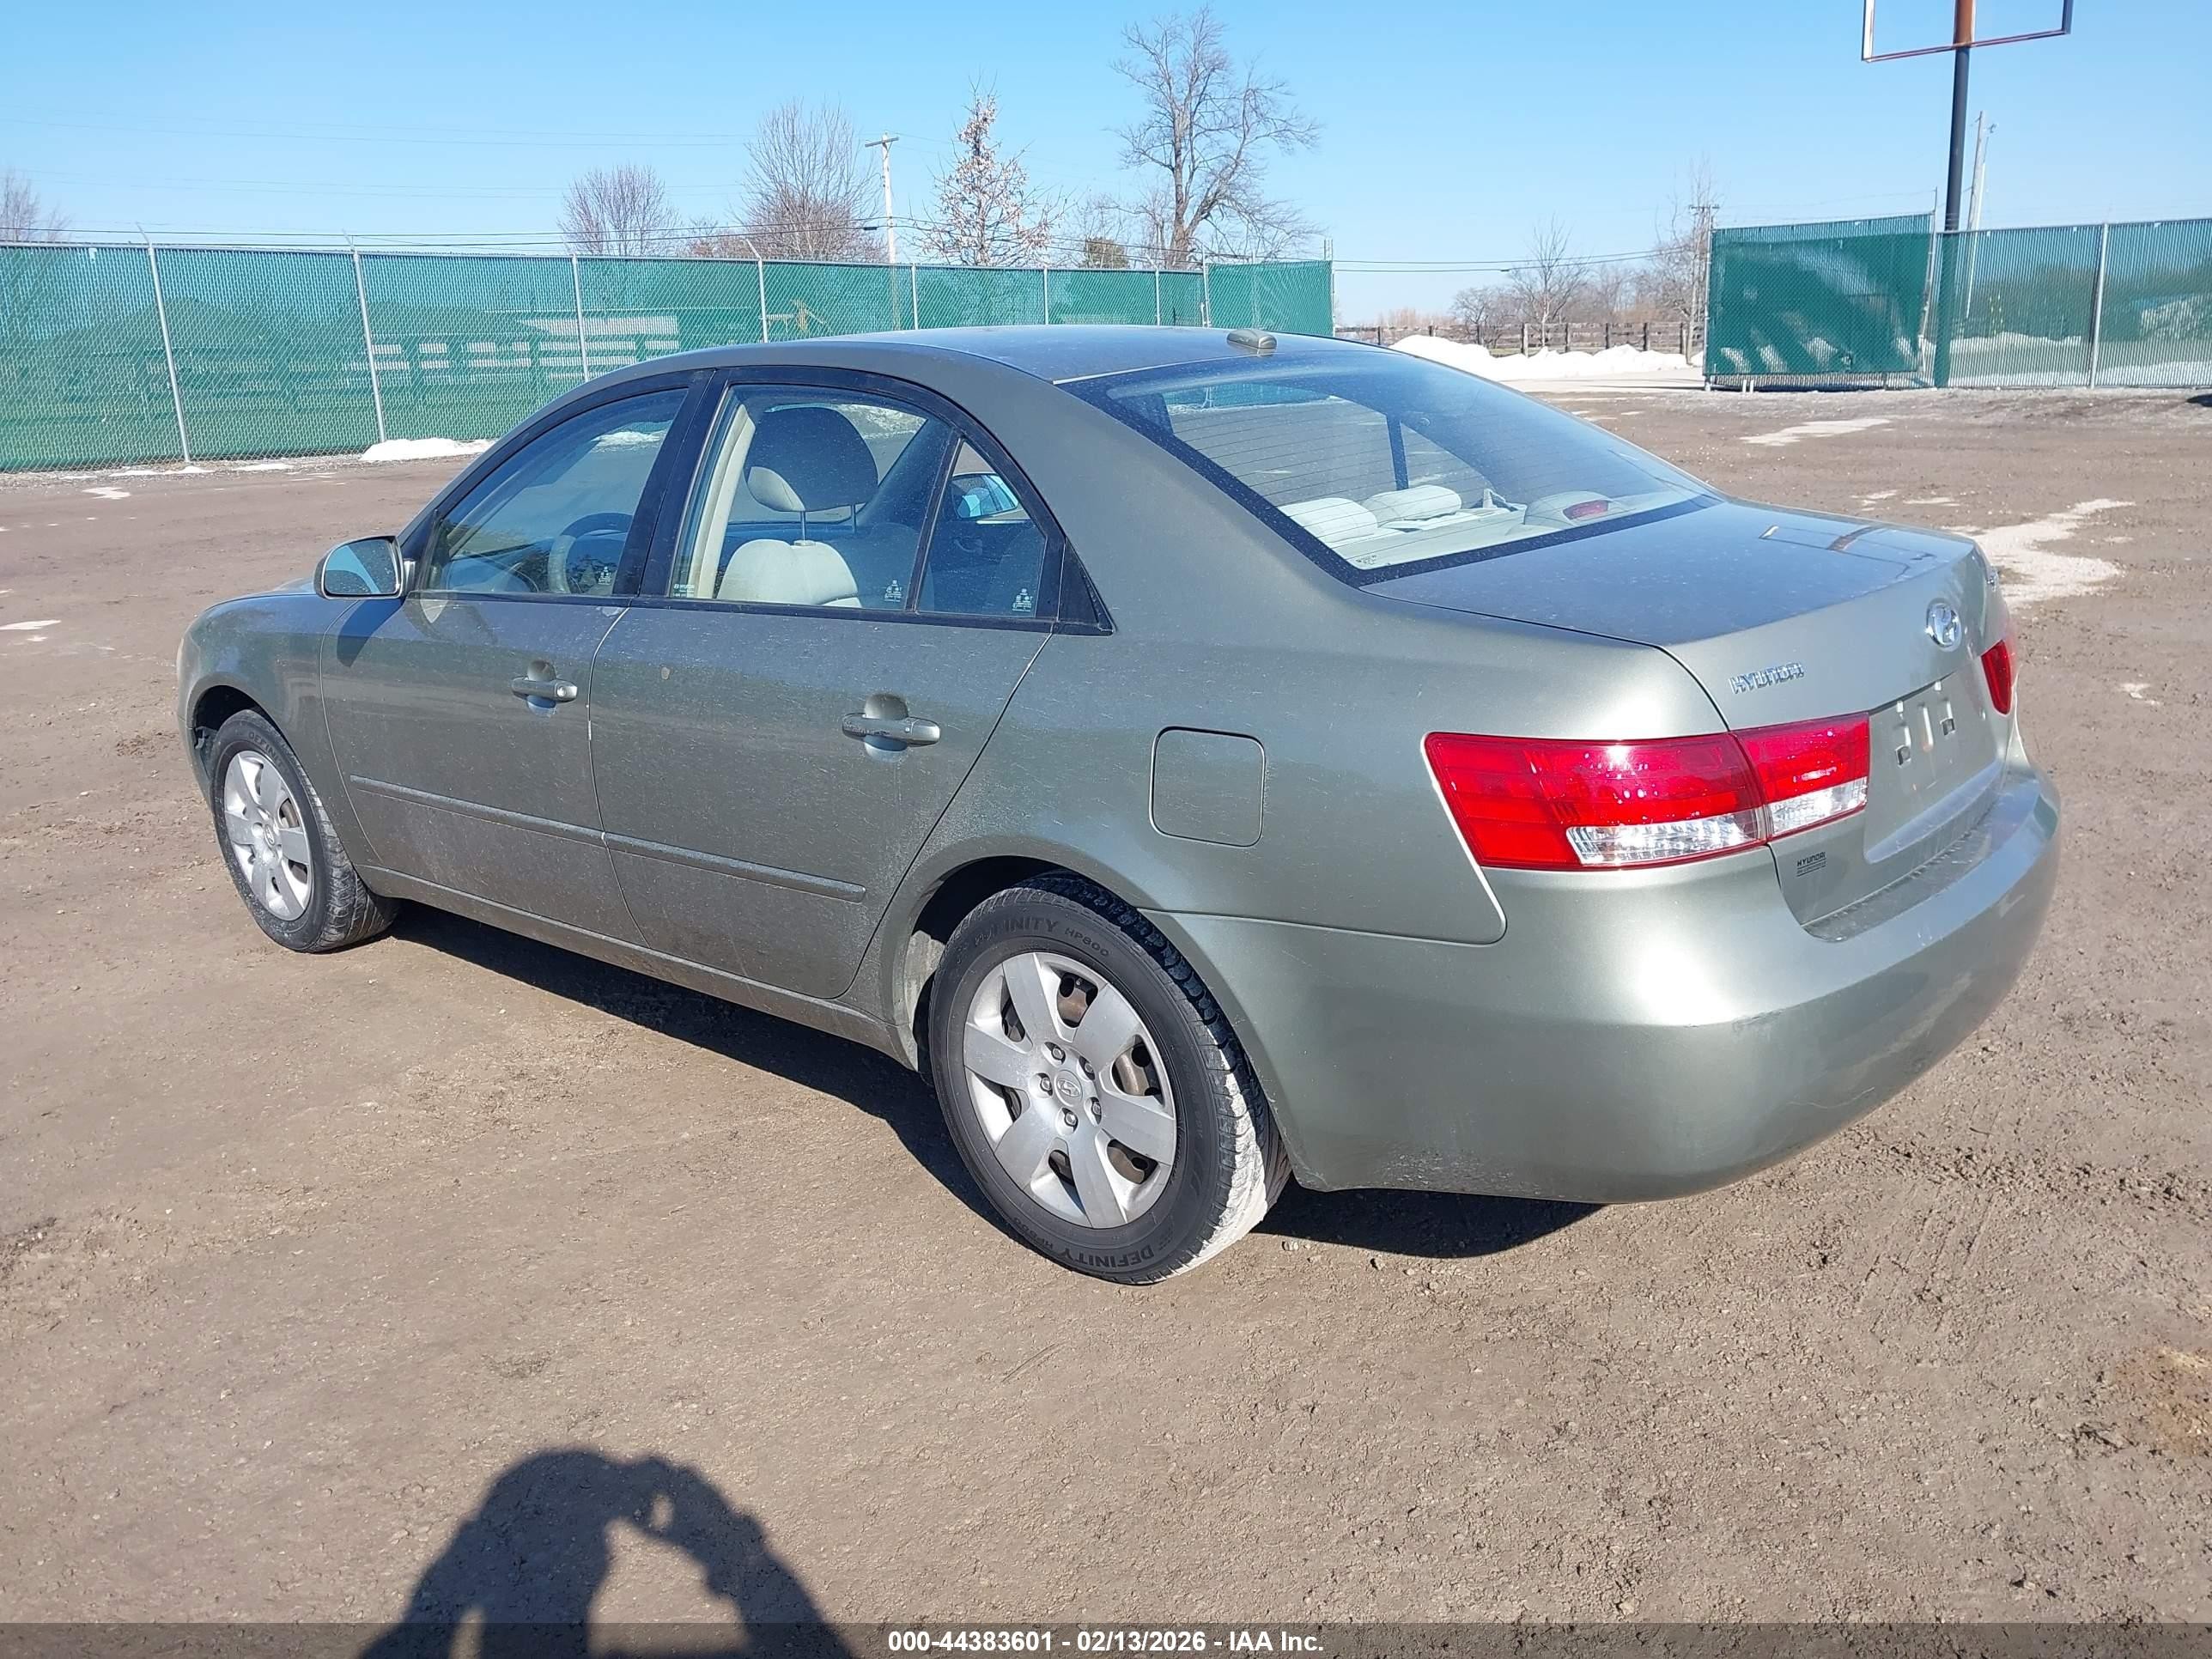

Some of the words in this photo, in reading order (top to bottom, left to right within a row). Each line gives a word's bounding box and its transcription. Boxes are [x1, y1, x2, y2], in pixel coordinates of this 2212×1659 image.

[1728, 662, 1805, 694] HYUNDAI
[1796, 851, 1826, 867] HYUNDAI
[1064, 927, 1109, 957] HP800
[1059, 1245, 1155, 1268] DEFINITY
